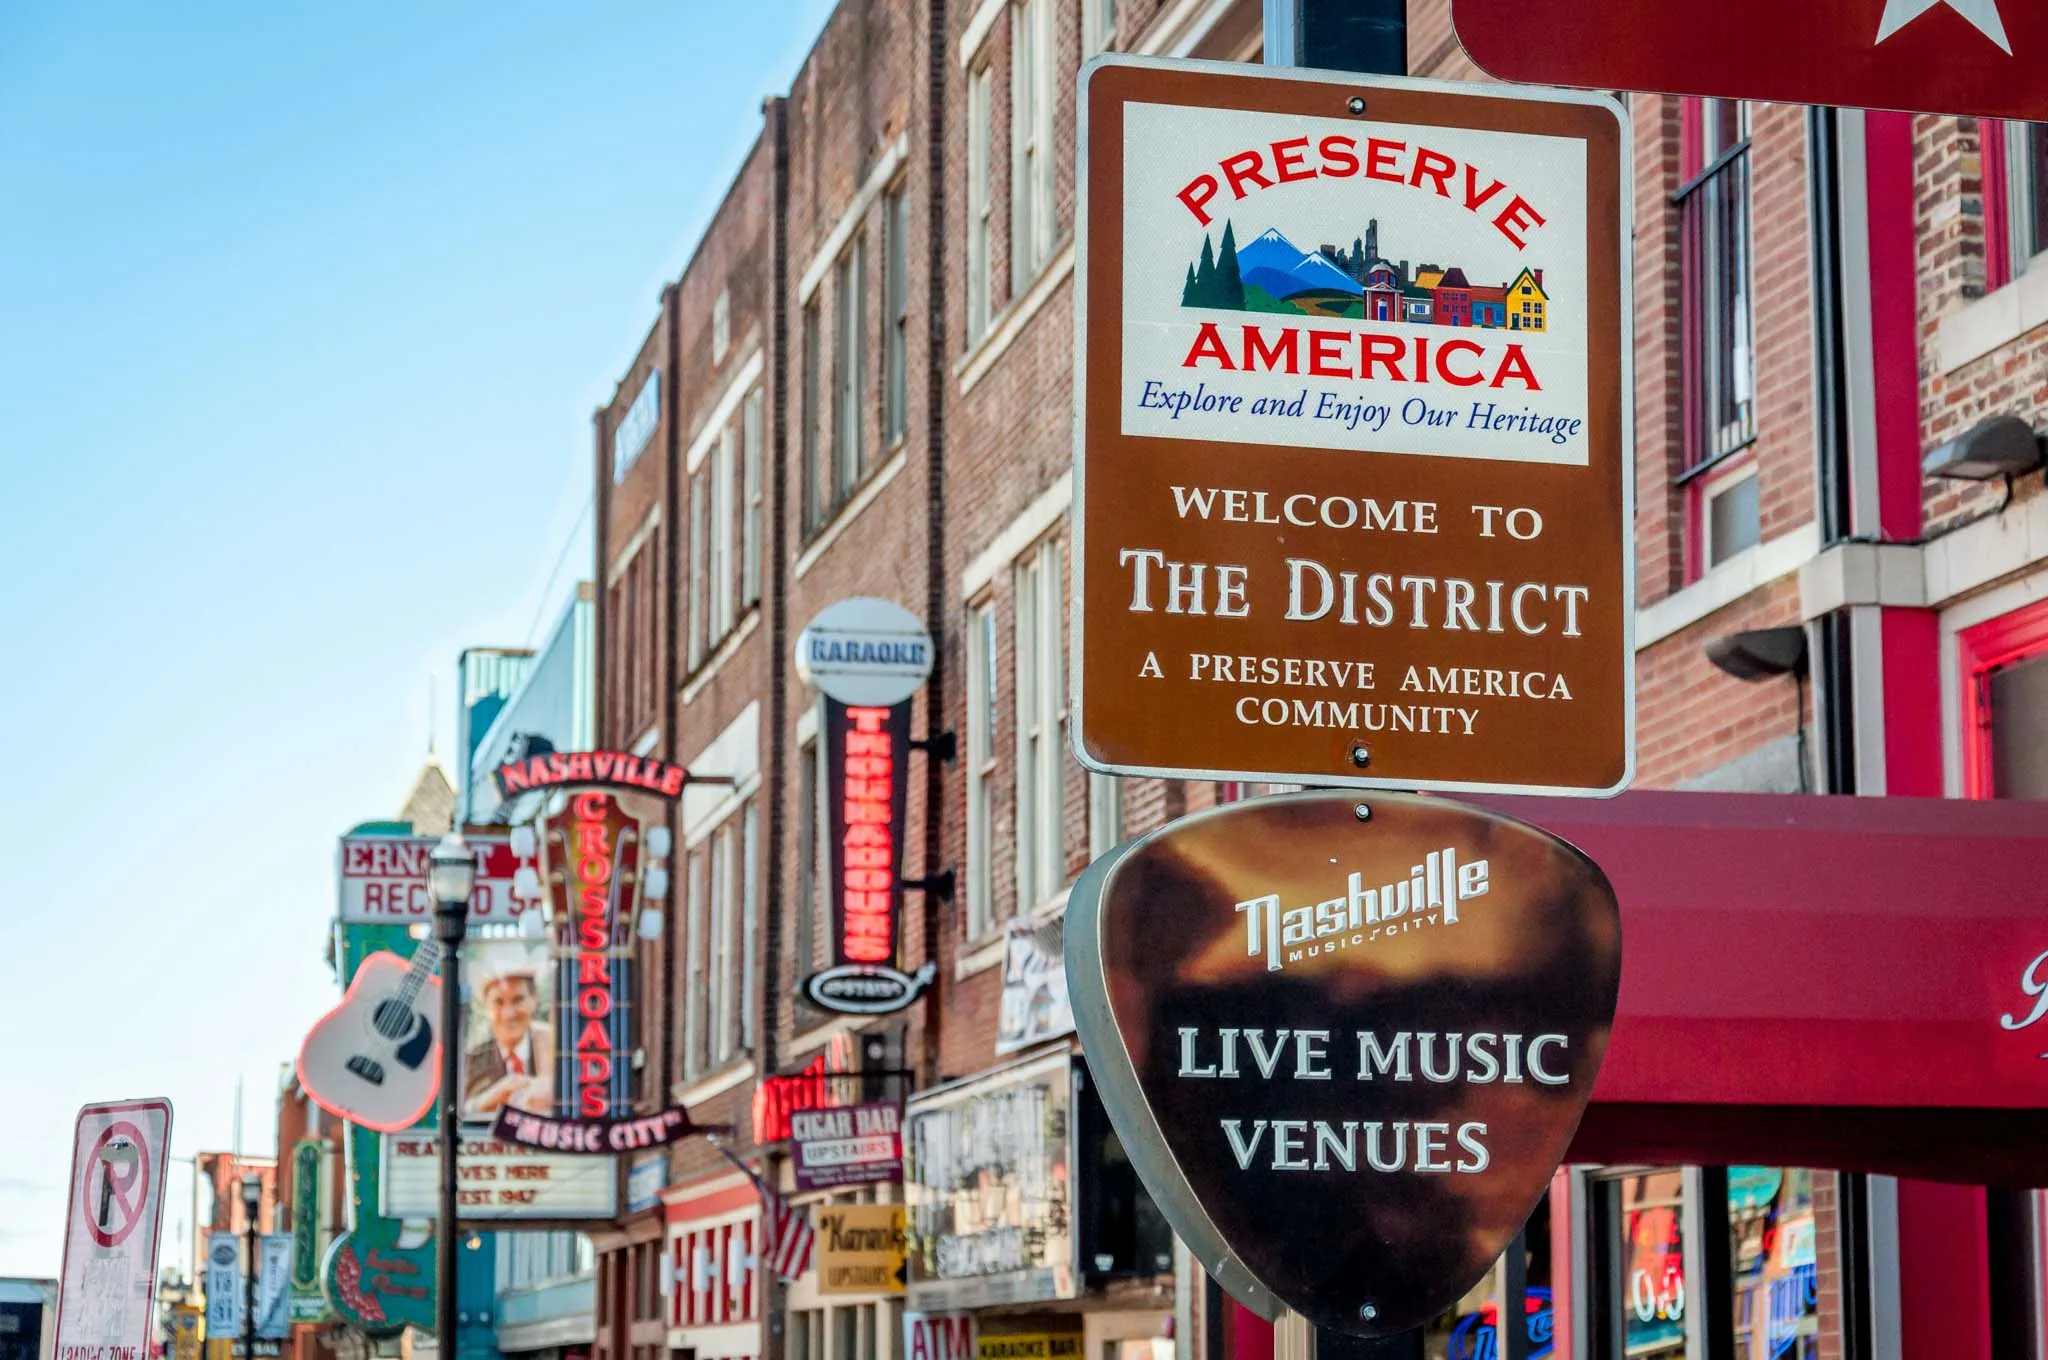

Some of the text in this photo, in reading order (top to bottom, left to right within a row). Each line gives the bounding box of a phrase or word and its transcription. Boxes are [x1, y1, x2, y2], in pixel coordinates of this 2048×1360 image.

[1176, 135, 1547, 251] PRESERVE
[1182, 322, 1542, 390] AMERICA
[1138, 380, 1582, 444] Explore and Enjoy Our Heritage
[1170, 485, 1543, 540] WELCOME TO
[1119, 547, 1589, 637] THE DISTRICT
[810, 638, 927, 666] KARAOKE
[1138, 651, 1573, 700] A PRESERVE AMERICA
[1235, 697, 1479, 735] COMMUNITY
[502, 750, 685, 797] NASHVILLE
[364, 883, 491, 916] RECD
[1235, 847, 1489, 972] Nashville
[574, 790, 612, 1118] CROSSROADS
[1289, 914, 1438, 962] MUSIC CITY
[1177, 1027, 1569, 1085] LIVE MUSIC
[792, 1106, 898, 1141] CIGAR BAR
[1220, 1119, 1490, 1173] VENUES
[808, 1140, 888, 1159] UPSTAIRS
[912, 1315, 971, 1360] ATM
